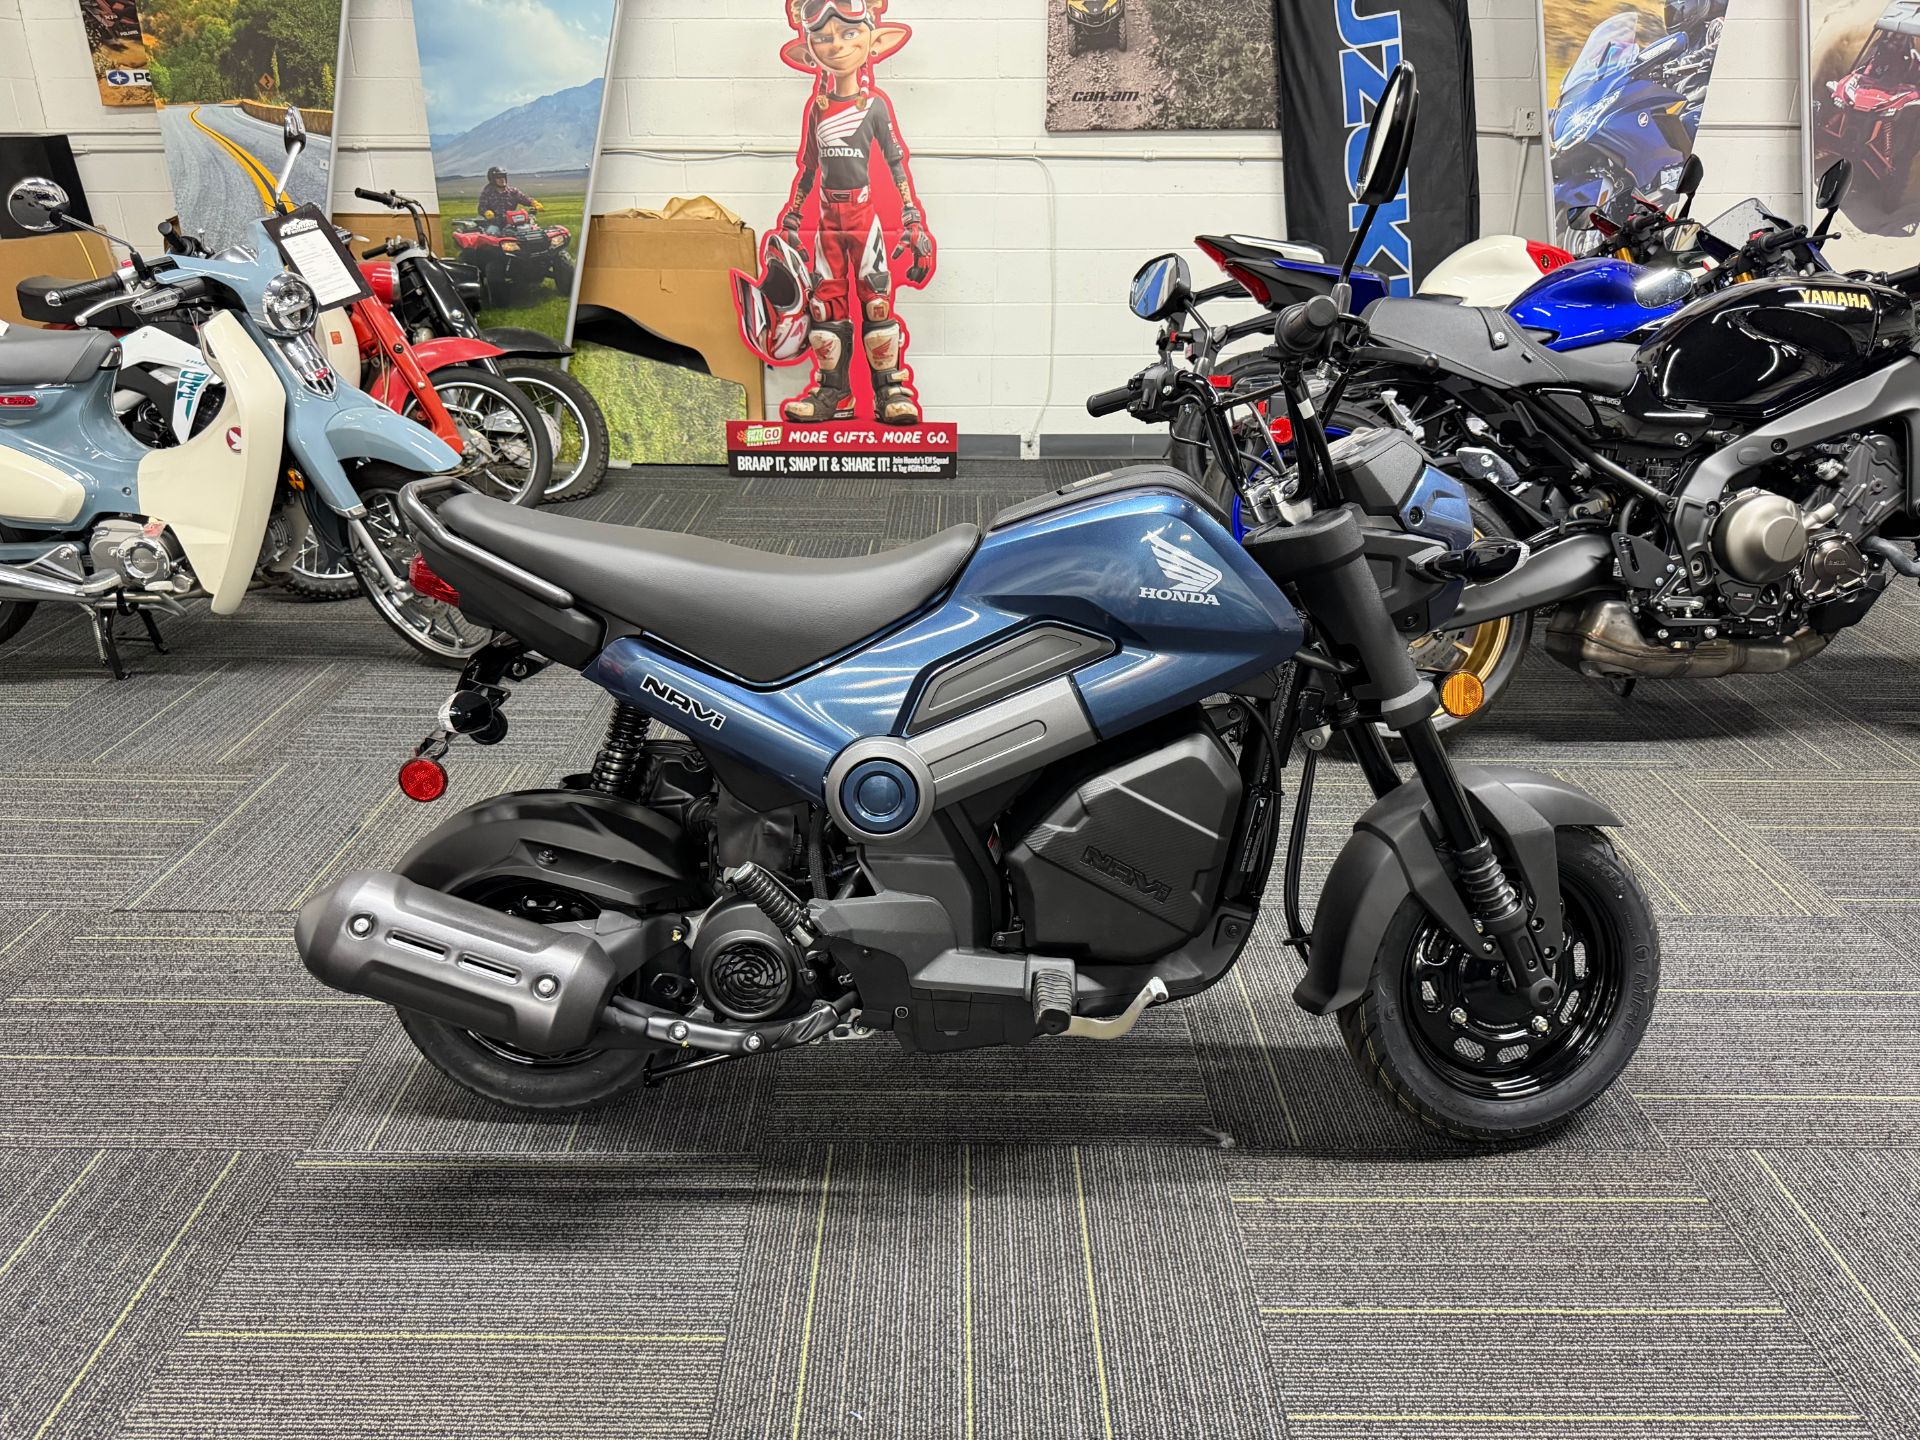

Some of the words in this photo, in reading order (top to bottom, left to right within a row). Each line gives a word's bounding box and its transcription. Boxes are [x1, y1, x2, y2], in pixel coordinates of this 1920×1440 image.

[1071, 91, 1140, 102] can-am
[820, 147, 864, 158] HONDA
[1797, 289, 1873, 310] YAMAHA
[764, 428, 779, 439] GO
[788, 431, 829, 444] MORE
[833, 431, 878, 444] GIFTS.
[882, 431, 923, 444] MORE
[927, 431, 949, 444] GO.
[737, 456, 773, 472] BRAAP
[775, 456, 788, 474] IT,
[789, 456, 818, 472] SNAP
[818, 456, 829, 472] IT
[831, 456, 840, 472] &
[841, 456, 875, 472] SHARE
[877, 456, 890, 472] IT!
[1139, 587, 1220, 606] HONDA
